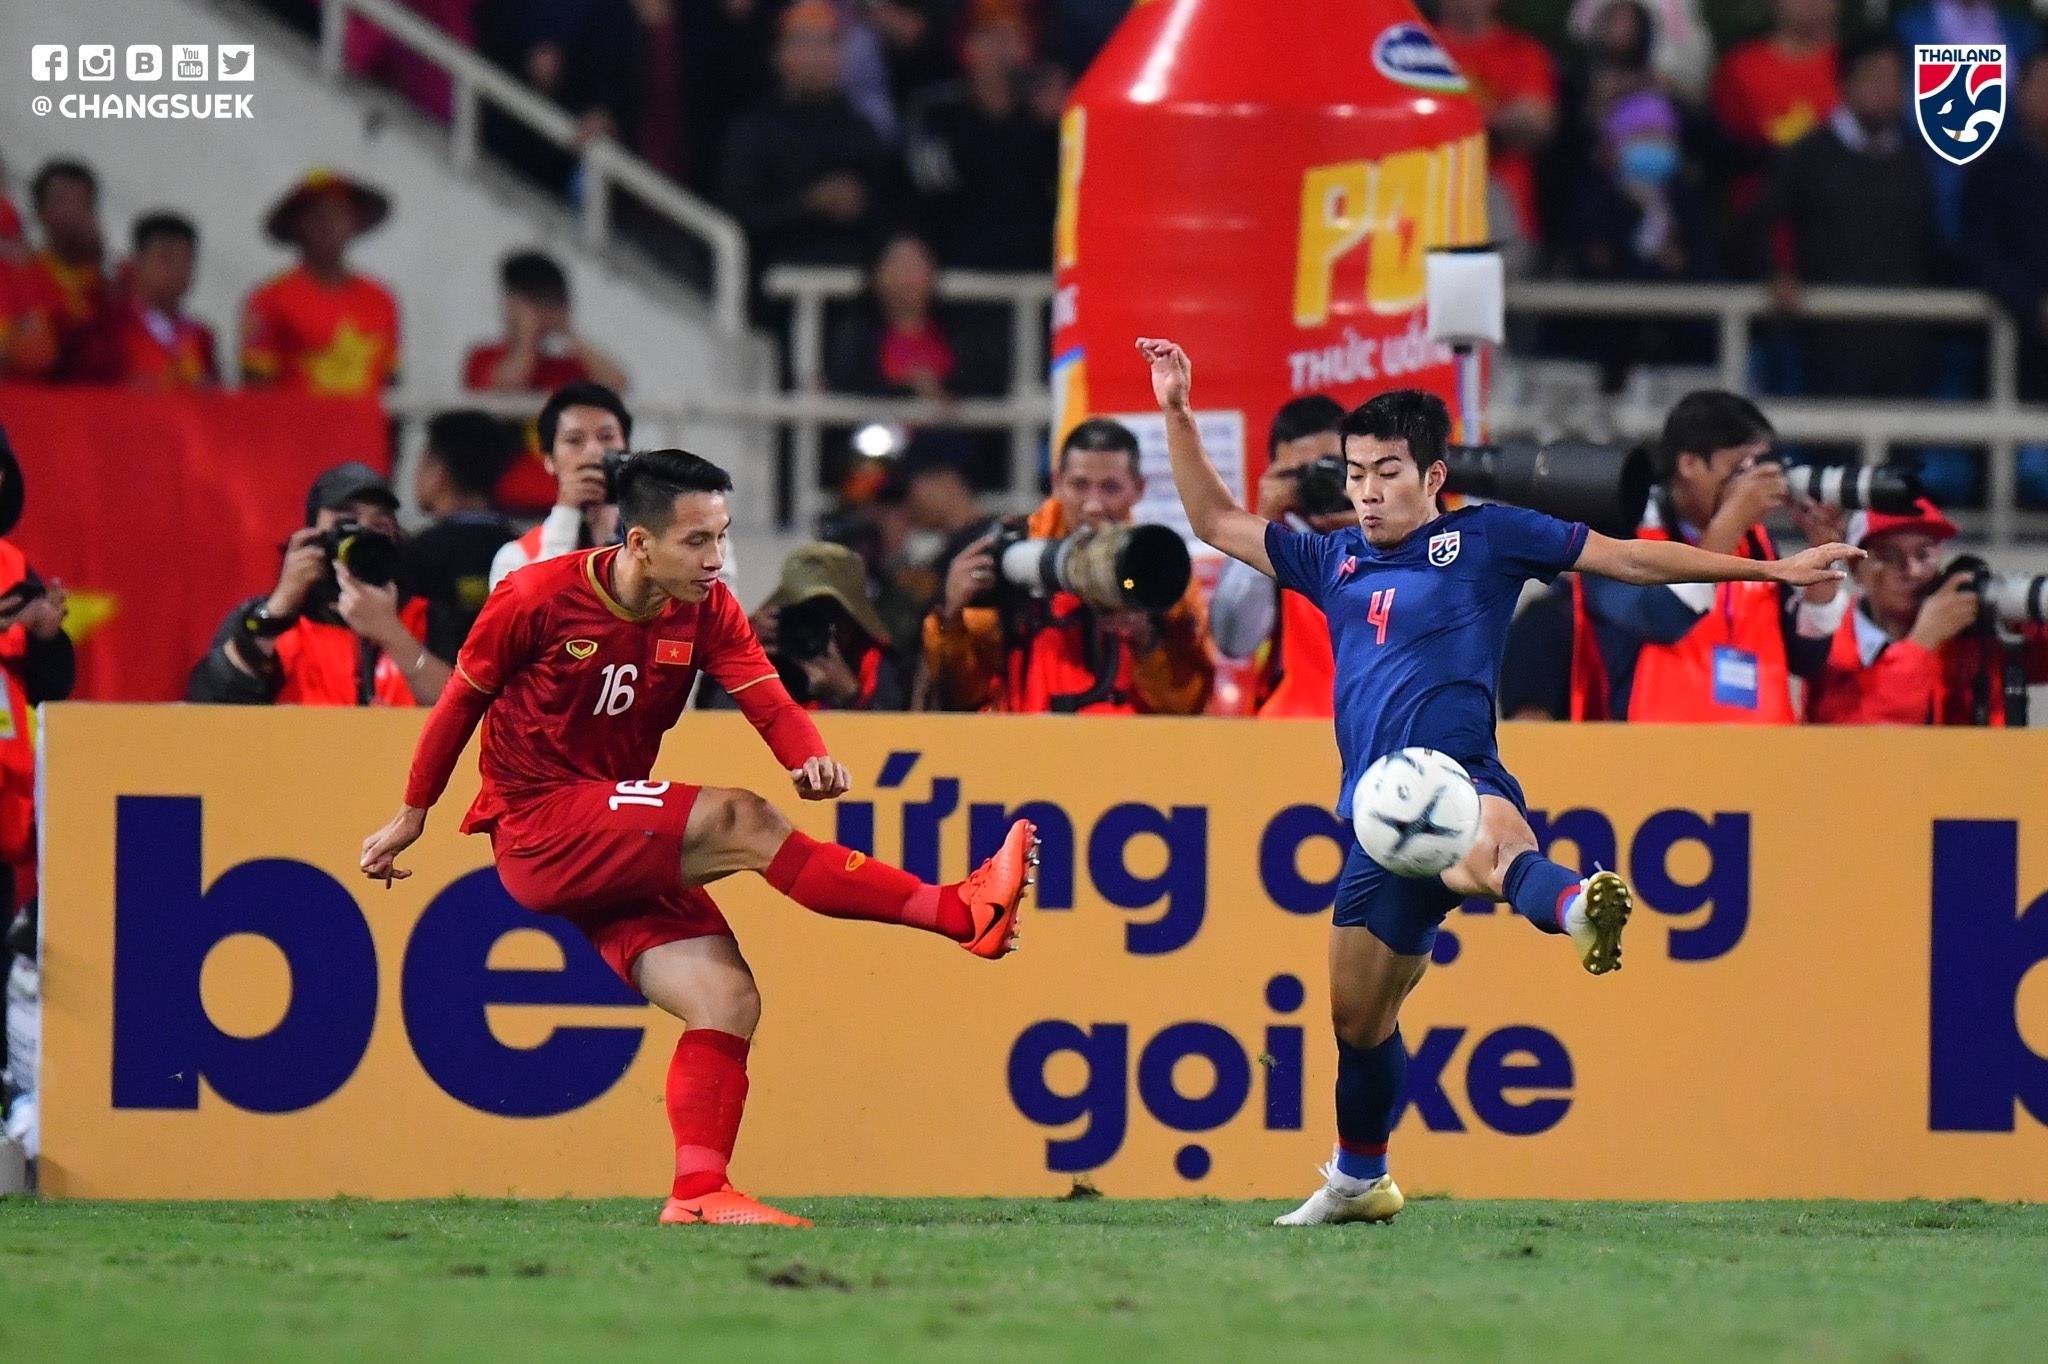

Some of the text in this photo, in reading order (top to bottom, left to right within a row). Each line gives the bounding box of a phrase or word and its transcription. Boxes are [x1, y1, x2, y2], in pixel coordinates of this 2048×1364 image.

[1366, 587, 1396, 645] 4
[593, 663, 638, 716] 16
[608, 779, 671, 811] 16
[110, 794, 650, 1118] be
[1006, 972, 1576, 1183] gọi xe
